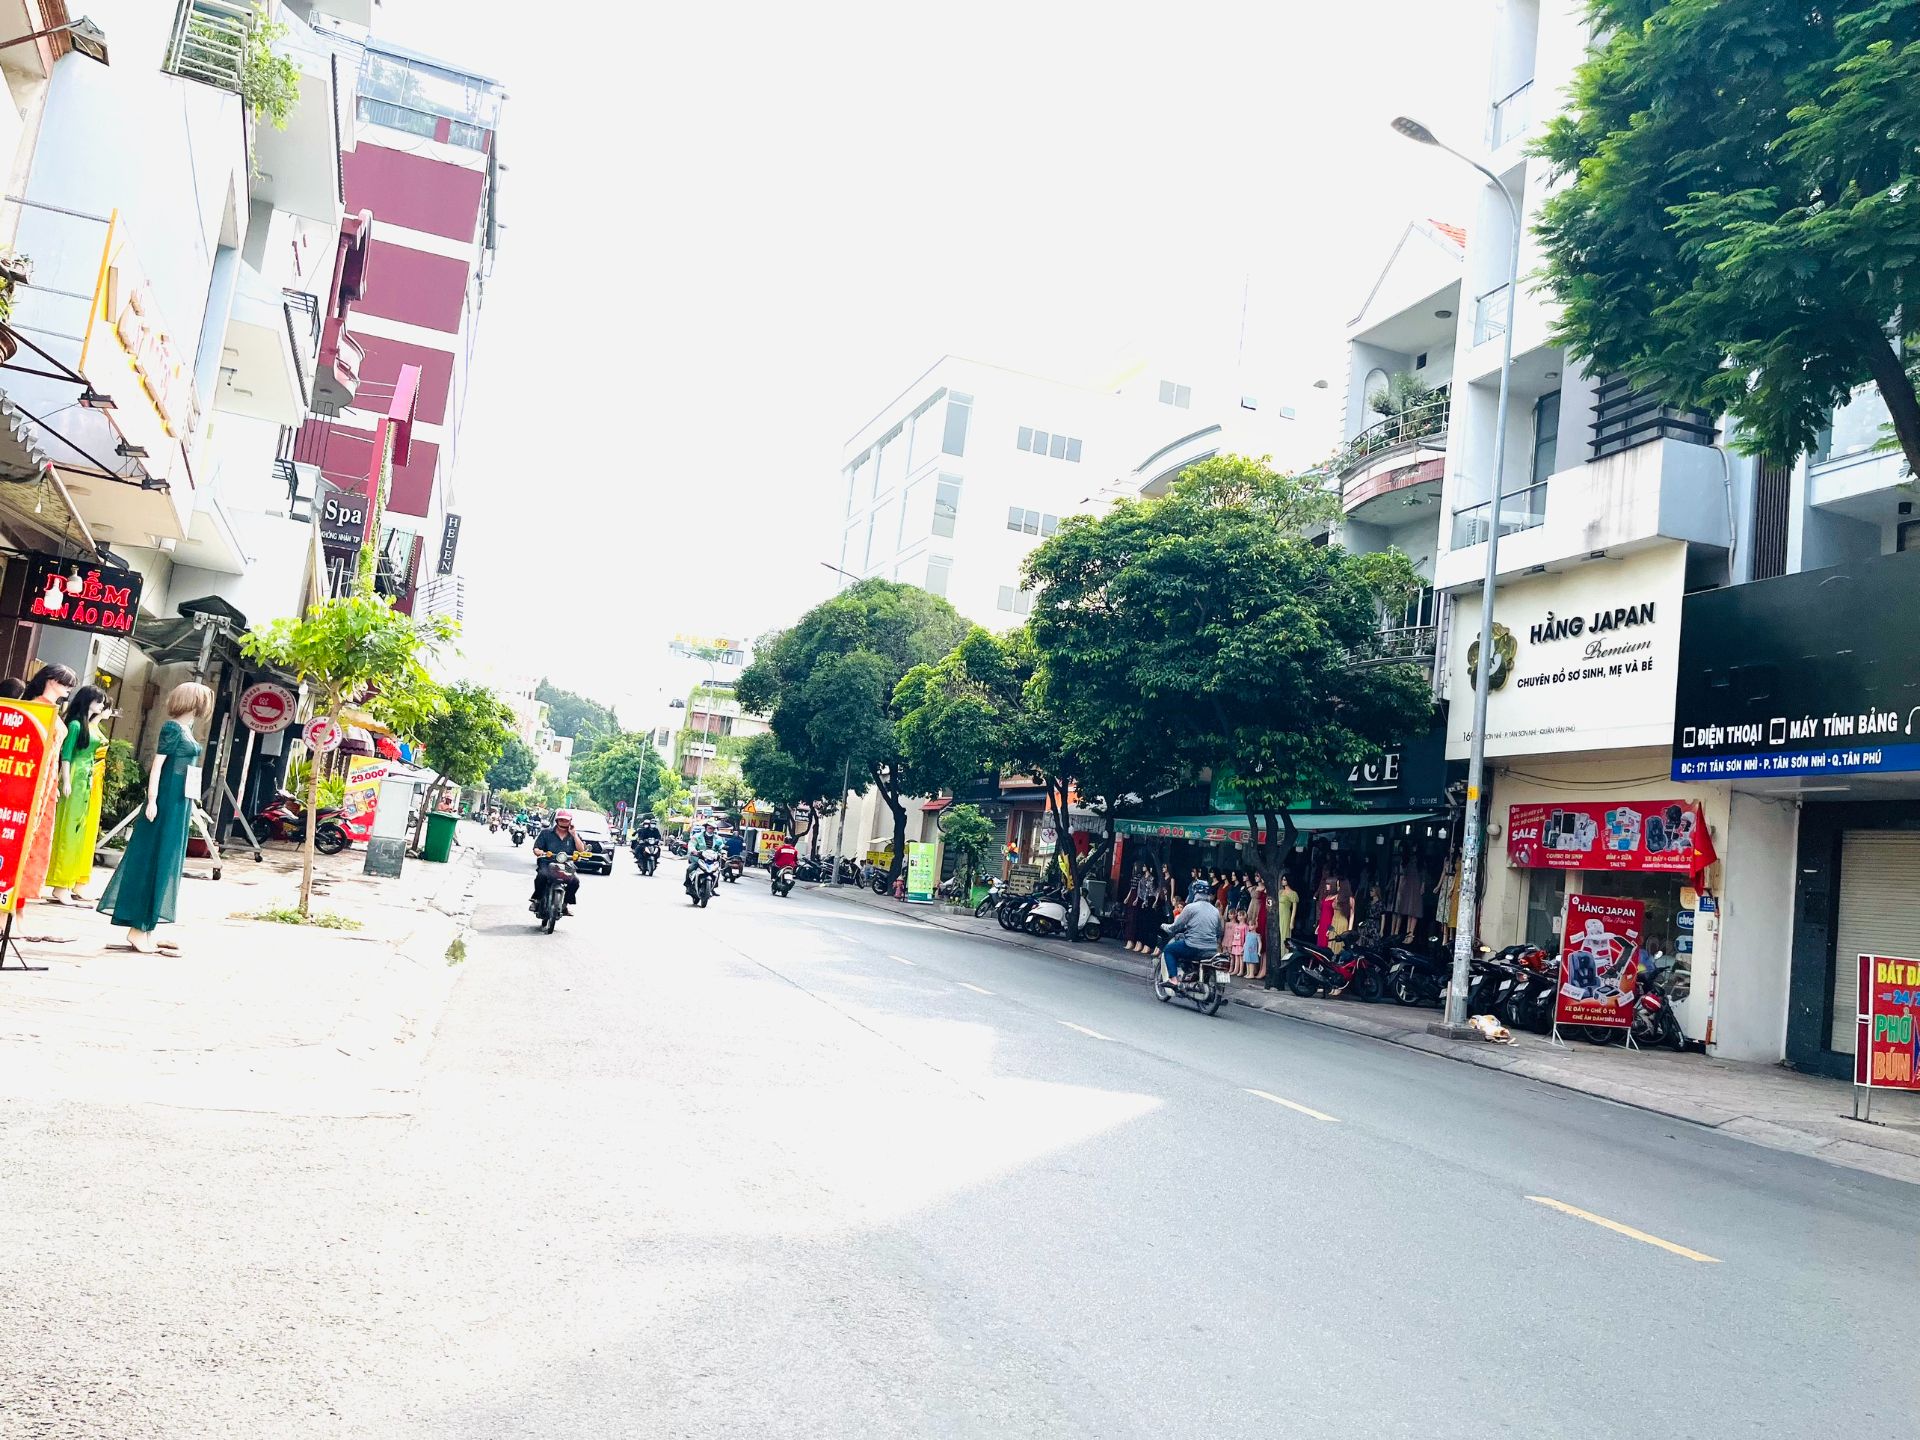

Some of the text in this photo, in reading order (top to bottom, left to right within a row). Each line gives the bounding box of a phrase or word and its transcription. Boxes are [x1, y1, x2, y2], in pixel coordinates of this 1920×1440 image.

[324, 499, 362, 527] Spa
[440, 517, 459, 571] HELEN
[44, 571, 131, 607] DỄM
[1530, 602, 1655, 644] HẰNG JAPAN
[1582, 637, 1652, 661] Premium
[1517, 672, 1551, 689] CHUYÊN
[1552, 667, 1566, 683] ĐỒ
[1567, 668, 1581, 681] SƠ
[1608, 664, 1622, 678] MẸ
[1625, 659, 1639, 673] VÀ
[1641, 656, 1654, 671] BÉ
[248, 721, 279, 731] HOTPOT
[1697, 706, 1898, 749] ĐIỆN THOẠI MÁY TÍNH BẢNG
[1681, 762, 1695, 774] ĐC:
[1697, 761, 1707, 773] 171
[1709, 758, 1724, 773] TÂN
[1726, 757, 1742, 772] SƠN
[1743, 756, 1758, 771] NHÌ
[1773, 755, 1789, 769] TÂN
[1791, 755, 1808, 768] SƠN
[1811, 753, 1826, 767] NHÌ
[1862, 749, 1882, 765] PHÚ
[1512, 827, 1538, 841] SALE
[1605, 906, 1636, 917] JAPAN
[1877, 960, 1905, 985] BÁT
[1874, 1006, 1913, 1045] PHỞ
[1873, 1046, 1911, 1082] BÚN
